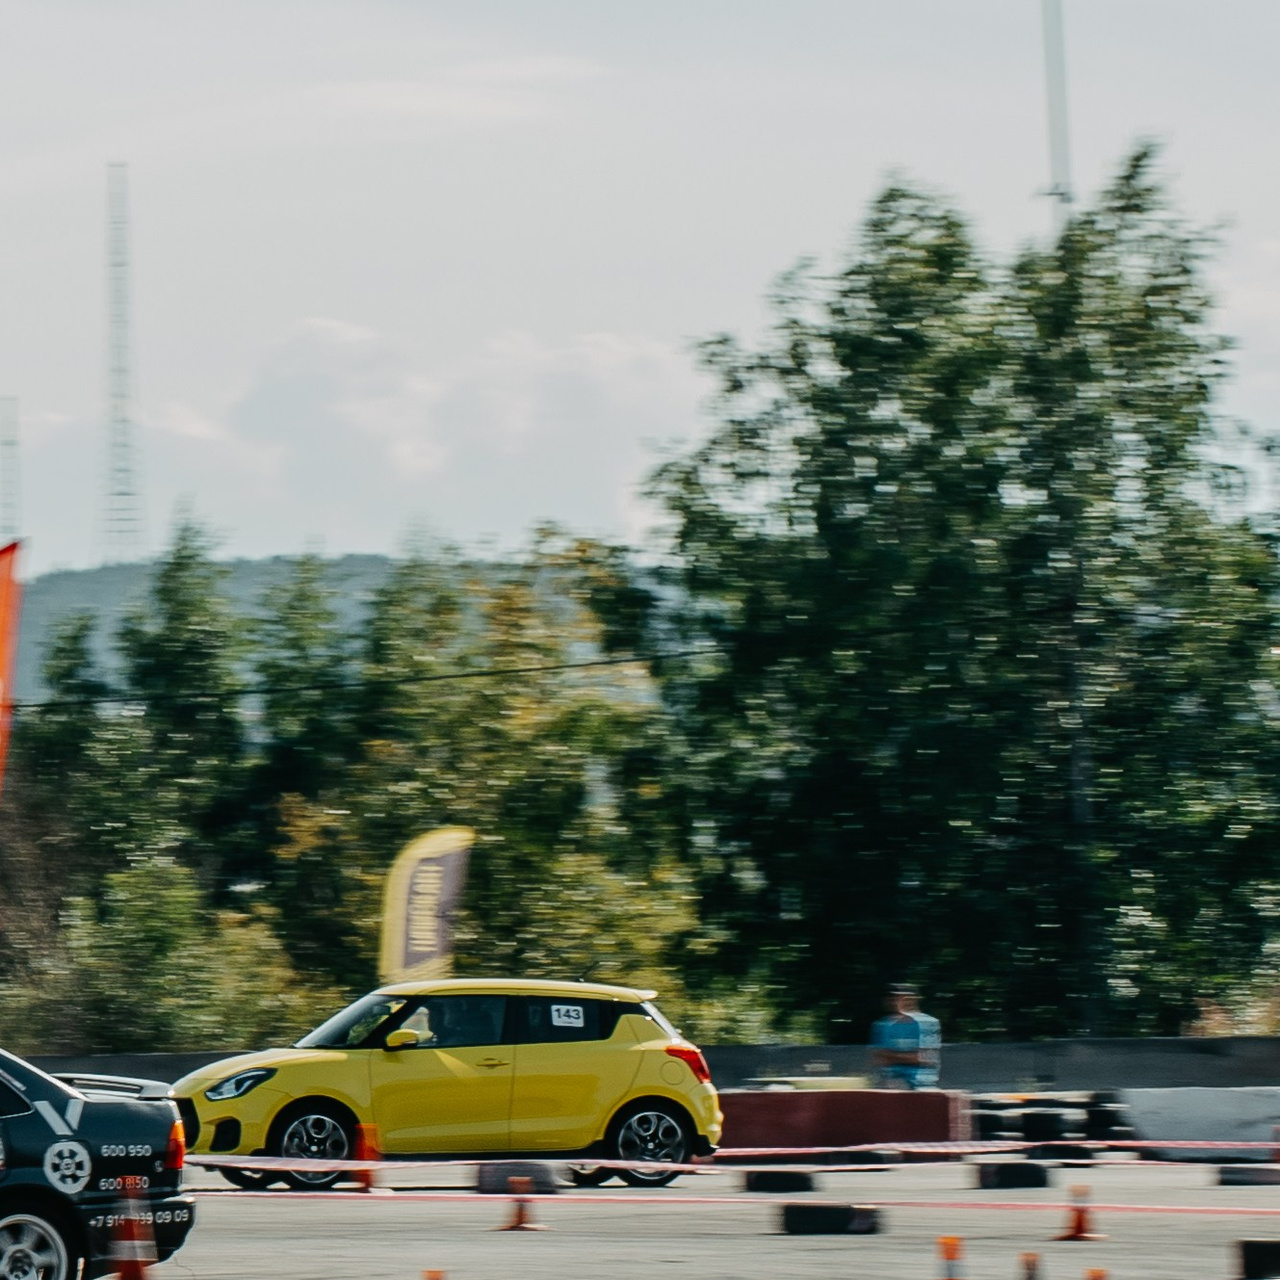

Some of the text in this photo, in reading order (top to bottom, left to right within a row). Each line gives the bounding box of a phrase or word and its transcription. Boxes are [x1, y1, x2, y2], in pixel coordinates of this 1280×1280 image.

[554, 1008, 581, 1020] 143
[100, 1144, 152, 1157] 600 950
[99, 1178, 123, 1191] 600
[155, 1211, 172, 1223] 09
[173, 1209, 189, 1222] 09
